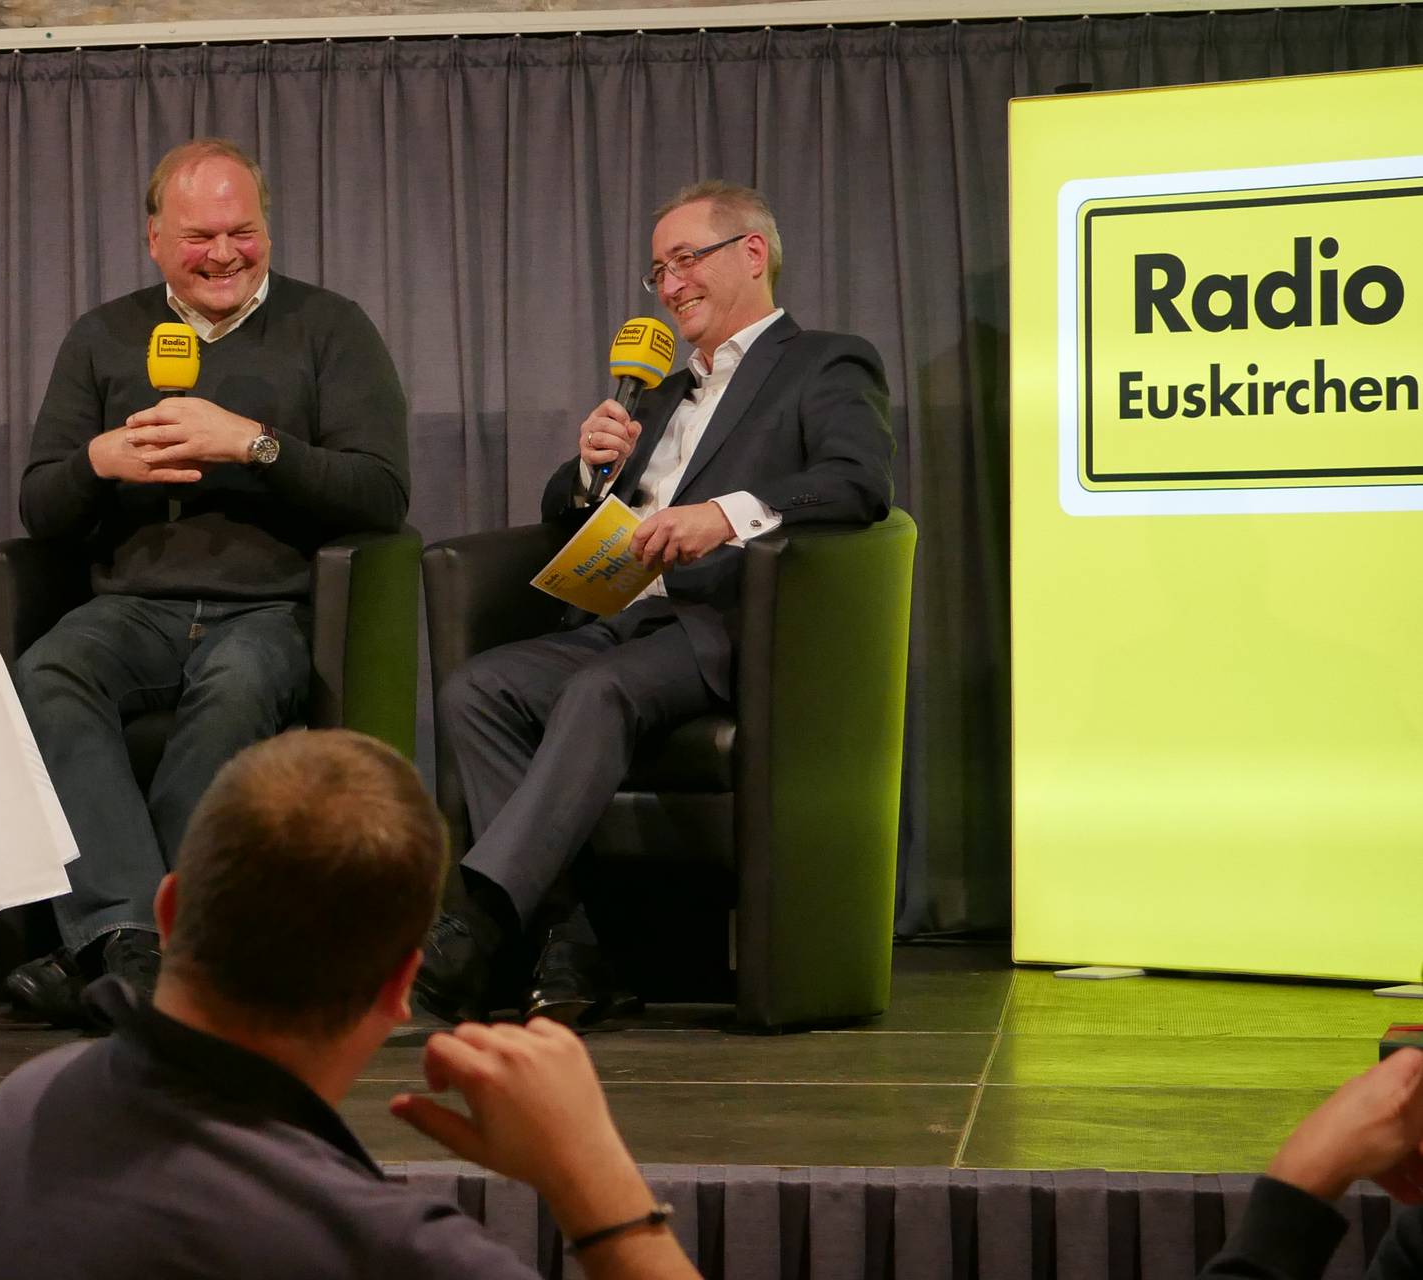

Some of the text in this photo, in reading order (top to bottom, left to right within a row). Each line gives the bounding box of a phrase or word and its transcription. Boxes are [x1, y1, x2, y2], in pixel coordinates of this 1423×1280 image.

[1134, 237, 1405, 335] Radio
[162, 338, 186, 346] Radio
[1118, 358, 1420, 420] Euskirchen
[572, 525, 629, 577] Menschen
